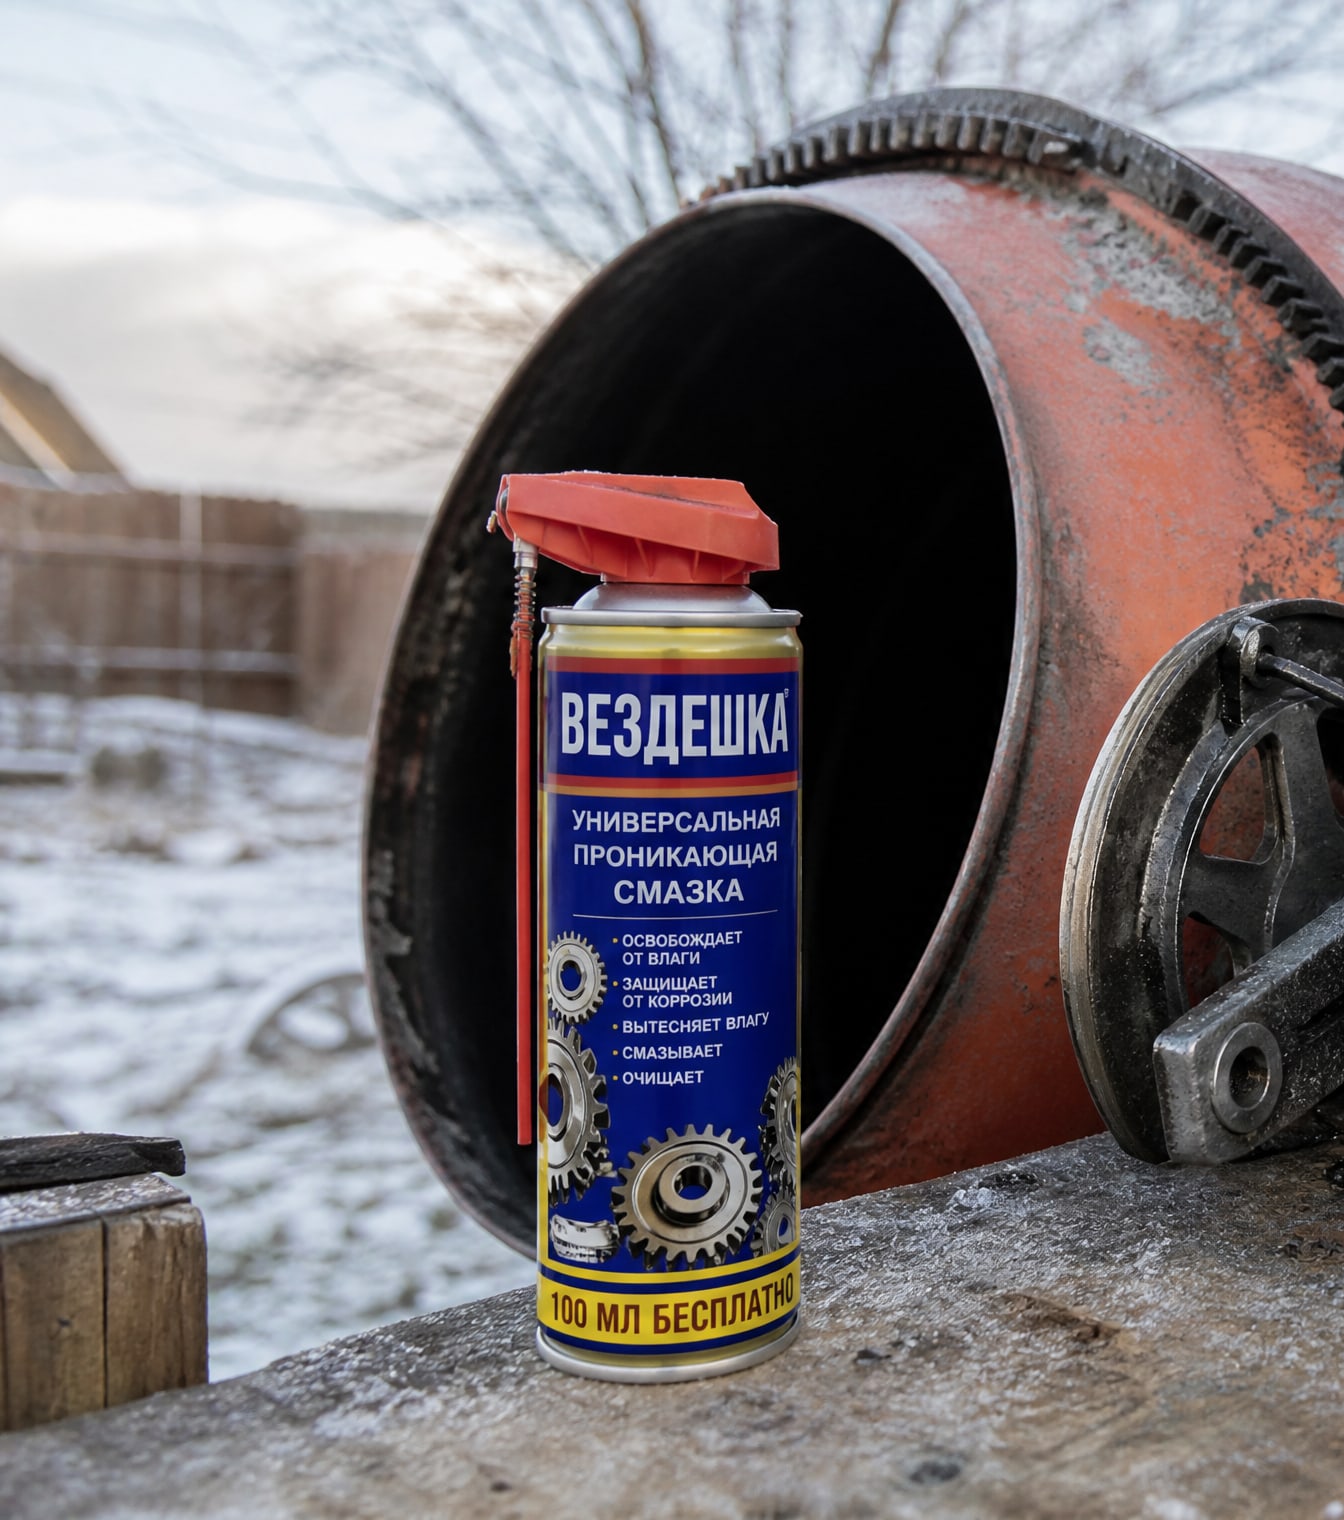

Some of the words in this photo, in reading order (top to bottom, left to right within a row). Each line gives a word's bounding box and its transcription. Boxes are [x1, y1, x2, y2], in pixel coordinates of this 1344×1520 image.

[561, 692, 789, 765] ВЕЗДЕШКА
[572, 807, 781, 833] УНИВЕРСАЛЬНАЯ
[573, 841, 778, 868] ПРОНИКАЮЩАЯ
[613, 878, 745, 904] СМАЗКА
[622, 931, 743, 949] ОСВОБОЖДАЕТ
[622, 952, 644, 965] ОТ
[648, 952, 700, 965] ВЛАГИ
[622, 976, 718, 992] ЗАЩИЩАЕТ
[622, 995, 644, 1008] ОТ
[648, 992, 733, 1008] КОРРОЗИИ
[622, 1018, 721, 1034] ВЫТЕСНЯЕТ
[726, 1012, 770, 1030] ВЛАГУ
[622, 1044, 723, 1060] СМАЗЫВАЕТ
[622, 1070, 704, 1087] ОЧИЩАЕТ
[551, 1291, 587, 1328] 100
[596, 1302, 640, 1334] МЛ
[653, 1272, 794, 1335] БЕСПЛАТНО
